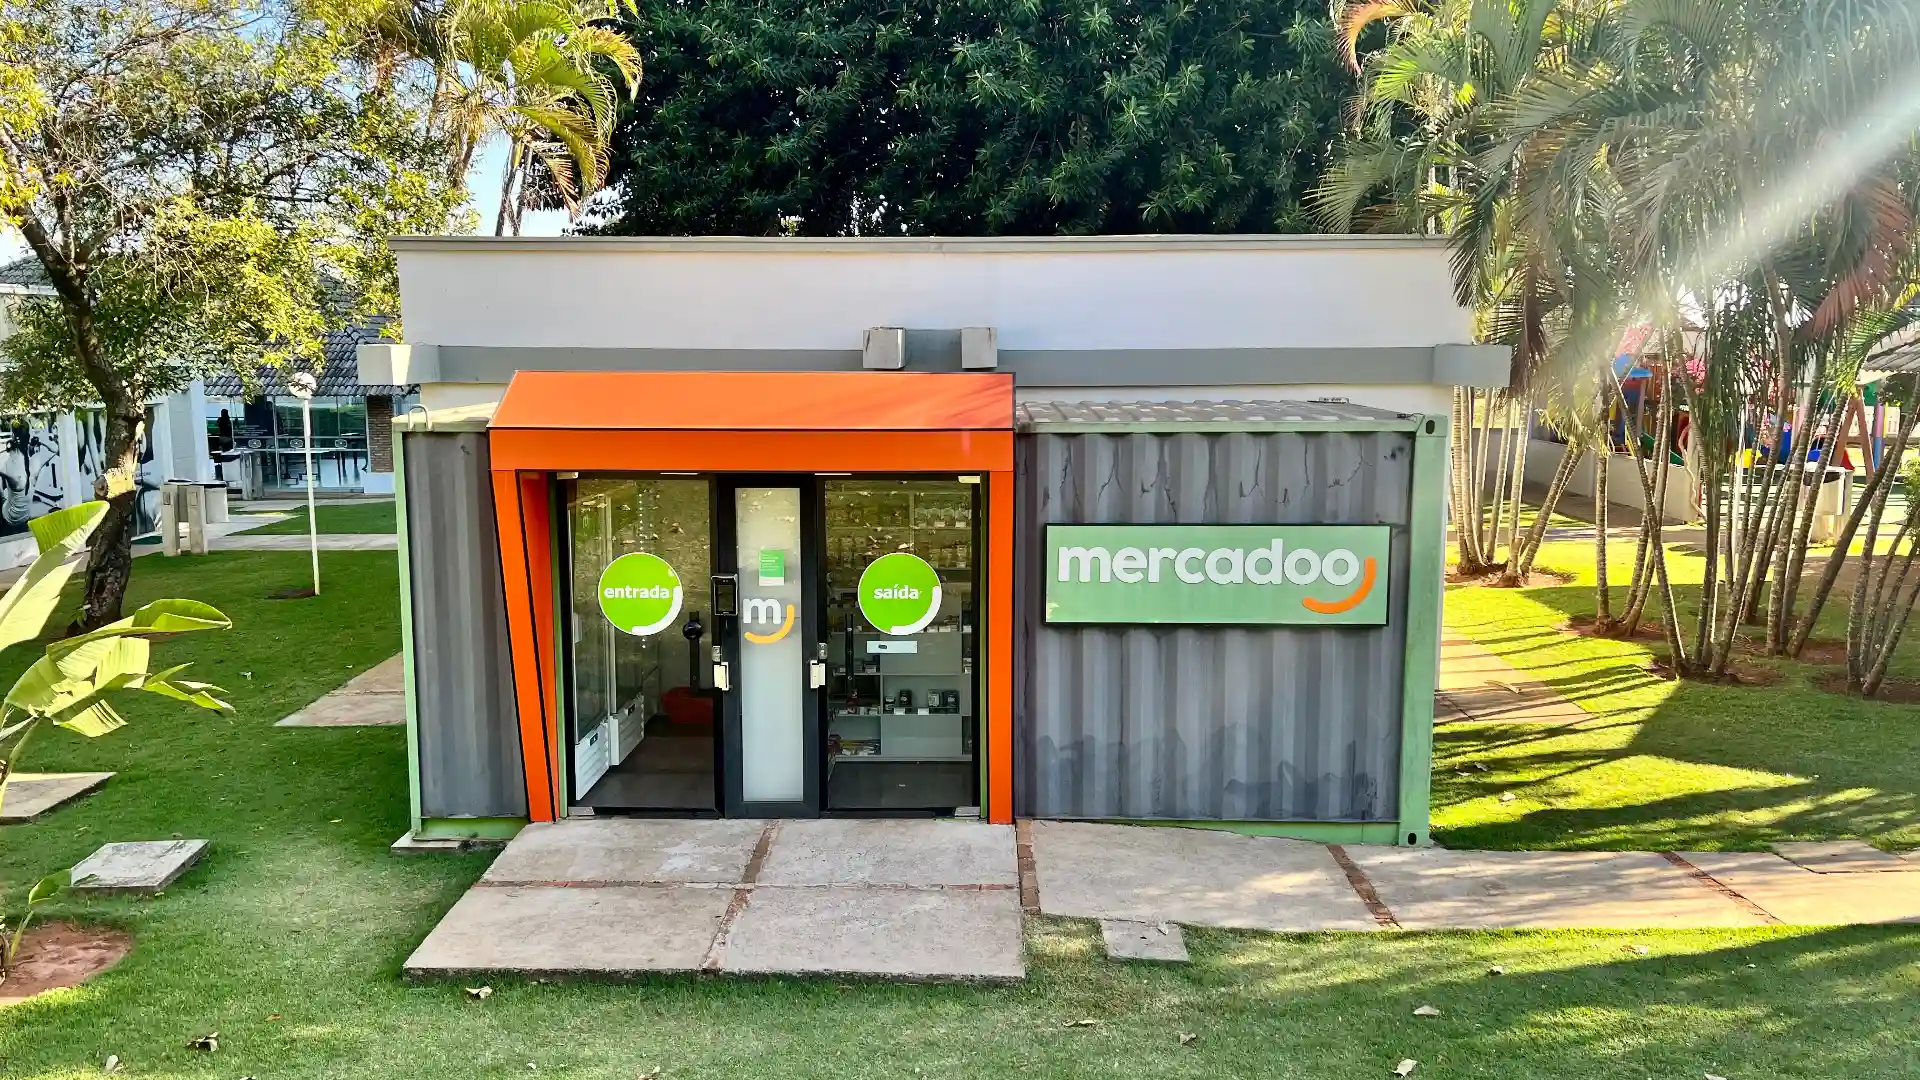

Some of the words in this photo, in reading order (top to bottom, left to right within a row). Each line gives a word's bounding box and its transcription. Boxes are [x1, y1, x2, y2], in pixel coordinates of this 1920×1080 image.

[1058, 538, 1360, 586] mercadoo
[604, 585, 670, 599] entrada
[873, 584, 919, 599] saída
[743, 598, 782, 624] m
